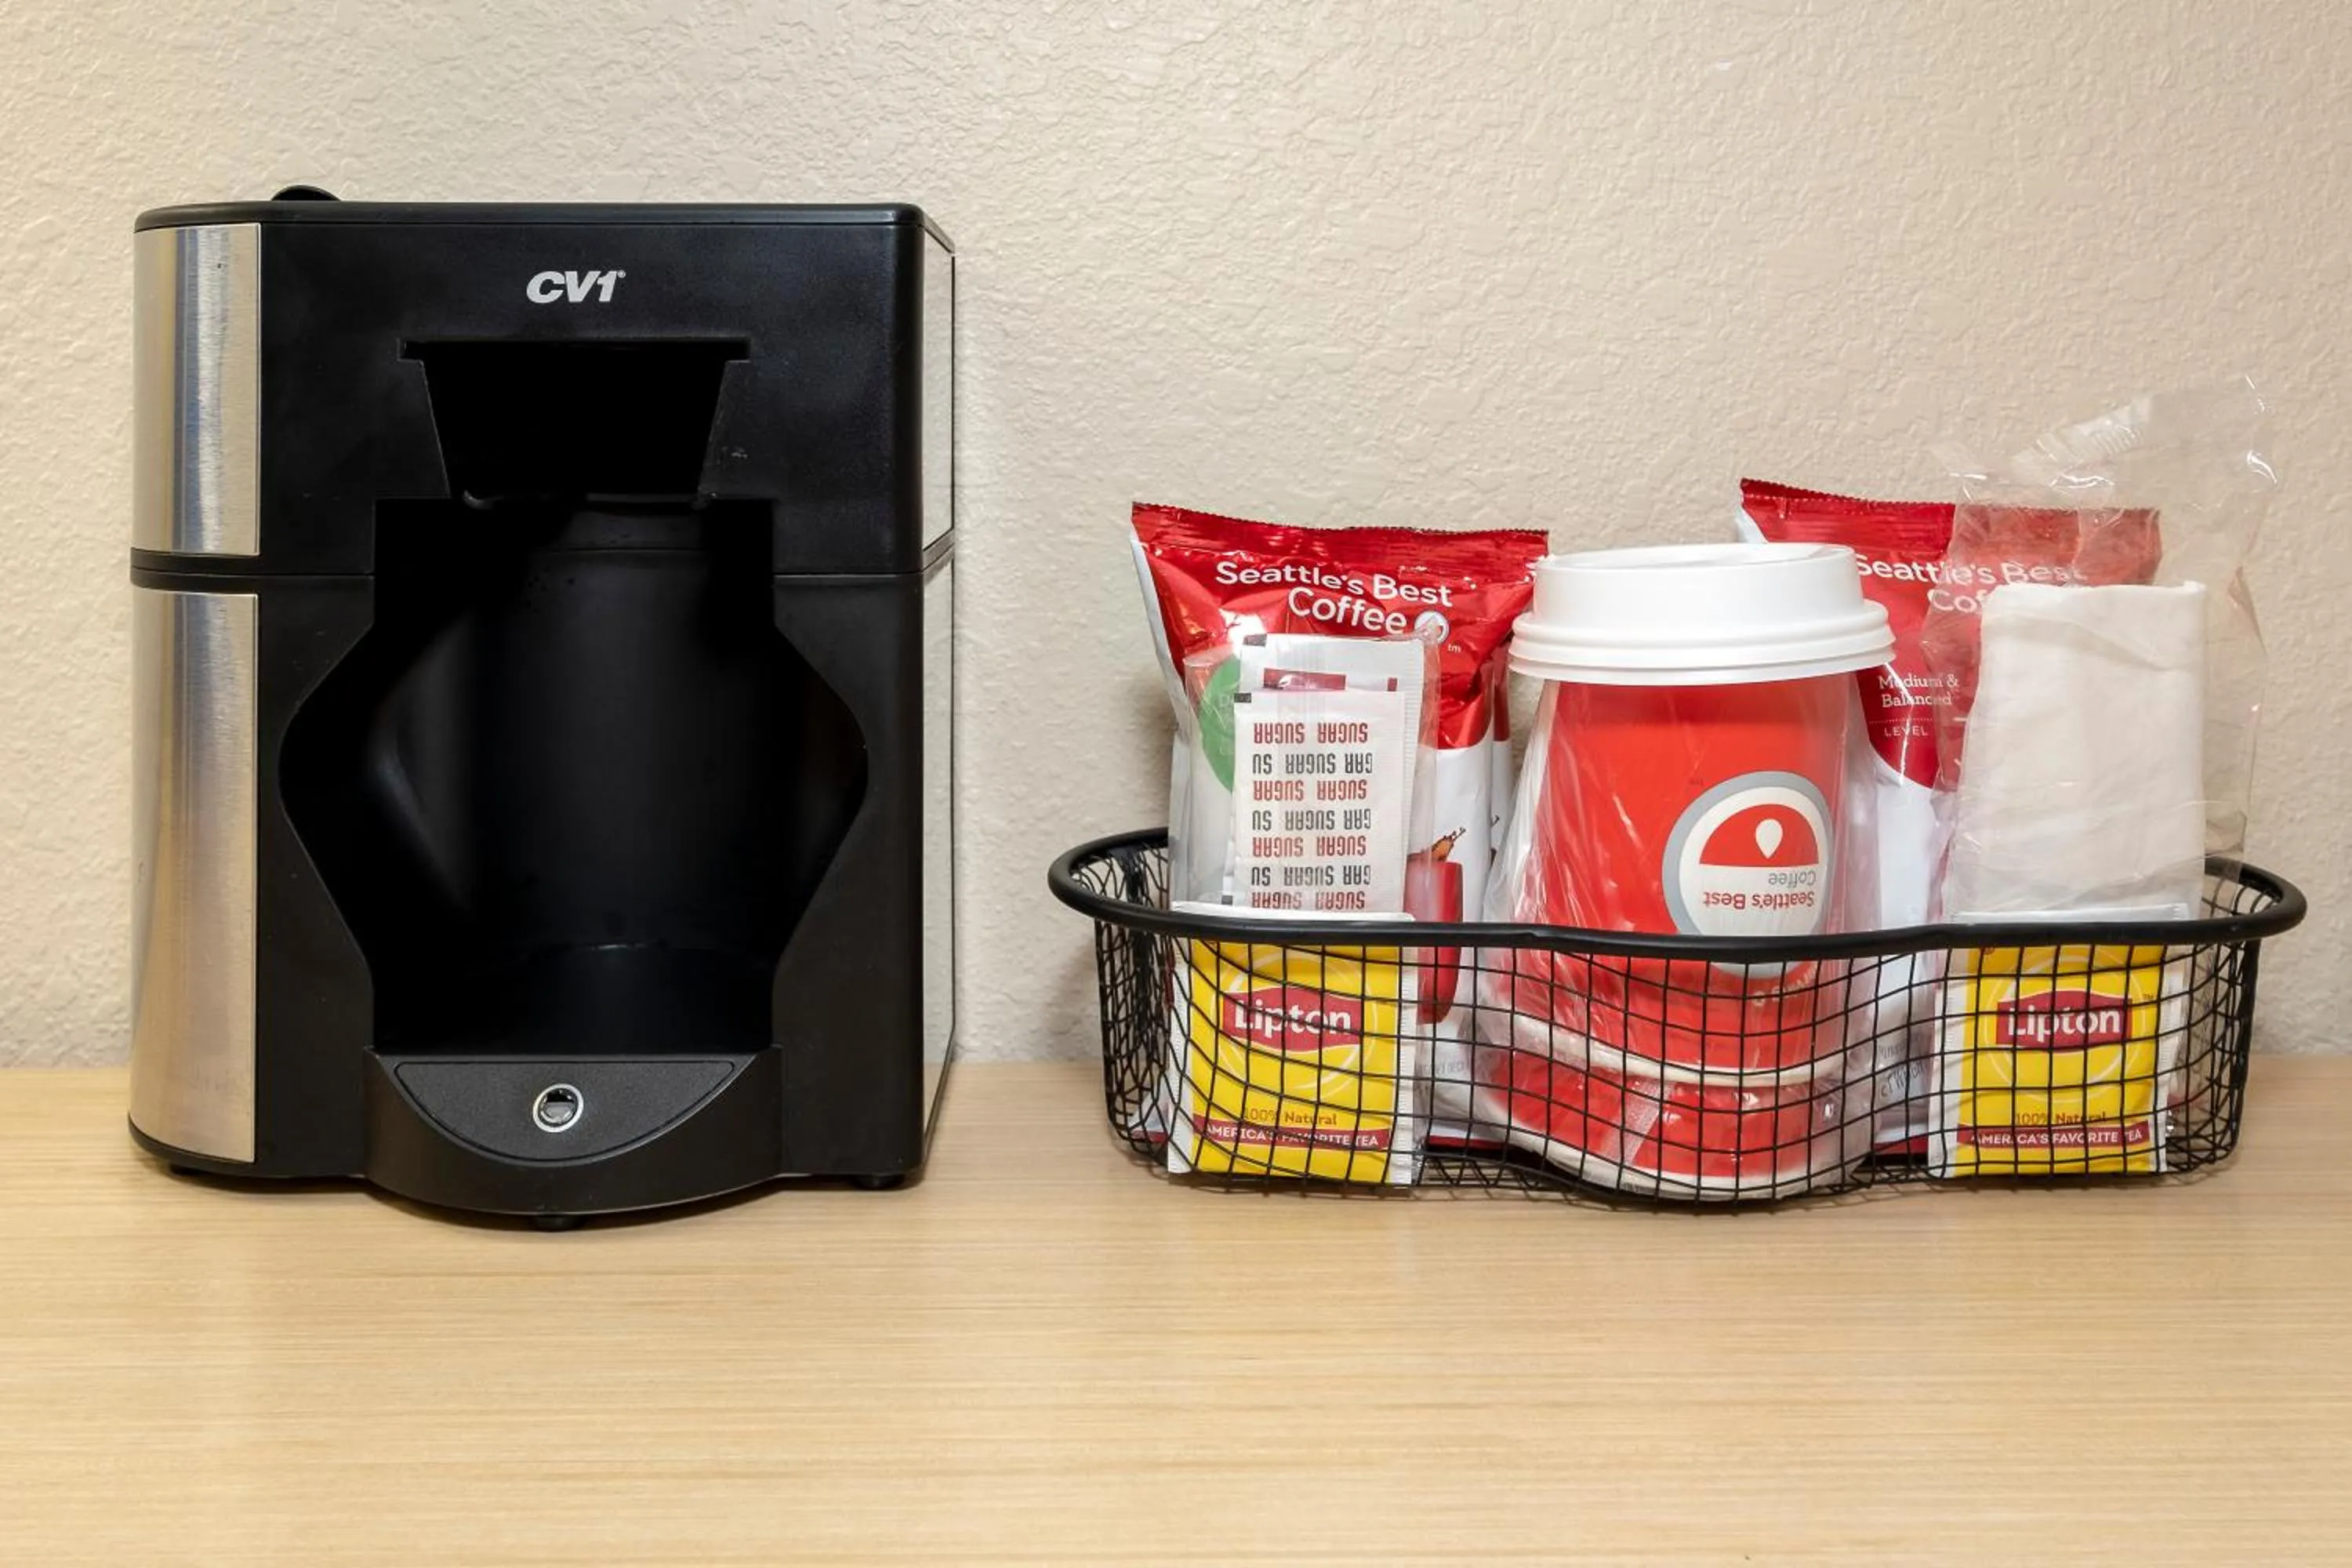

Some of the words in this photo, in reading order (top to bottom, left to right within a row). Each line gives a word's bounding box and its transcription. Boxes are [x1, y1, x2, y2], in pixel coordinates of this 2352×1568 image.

[1856, 554, 1997, 586] Seattle's
[2000, 561, 2089, 585] Best
[1215, 561, 1364, 595] Seattle's
[1373, 573, 1454, 608] Best
[1288, 586, 1408, 635] Coffee
[1946, 673, 1958, 688] &
[1254, 722, 1305, 744] SUGAR
[1317, 722, 1368, 744] SUGAR
[1884, 725, 1929, 737] LEVEL
[1252, 753, 1272, 775] SU
[1285, 753, 1336, 775] SUGAR
[1345, 752, 1374, 774] GAR
[1254, 779, 1305, 801] SUGAR
[1316, 779, 1368, 801] SUGAR
[1252, 809, 1272, 831] SU
[1284, 809, 1335, 831] SUGAR
[1343, 808, 1371, 830] GAR
[1252, 837, 1304, 858] SUGAR
[1316, 835, 1367, 857] SUGAR
[1250, 866, 1271, 887] SU
[1283, 865, 1334, 887] SUGAR
[1342, 865, 1371, 885] GAR
[1768, 870, 1817, 887] Coffee
[1251, 891, 1302, 909] SUGAR
[1315, 890, 1366, 910] SUGAR
[1704, 891, 1747, 909] Best
[1751, 891, 1815, 910] Seattle's
[1235, 999, 1352, 1039] Lipton
[2008, 1004, 2121, 1043] Lipton
